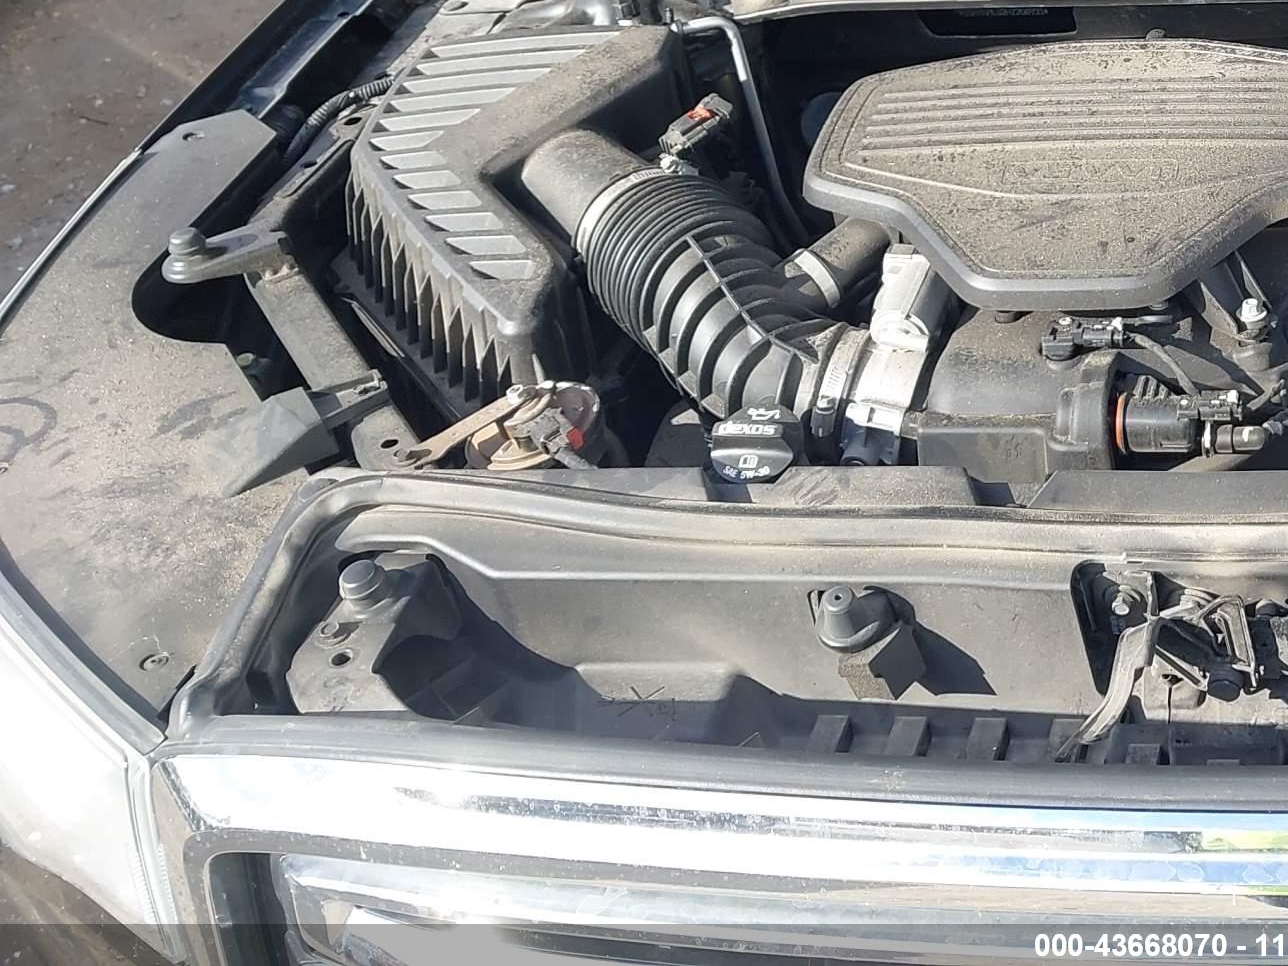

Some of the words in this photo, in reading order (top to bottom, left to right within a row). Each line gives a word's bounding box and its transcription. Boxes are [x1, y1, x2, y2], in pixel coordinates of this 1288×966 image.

[719, 420, 777, 435] dexos
[723, 465, 738, 478] SAE
[739, 465, 771, 479] 5W-30
